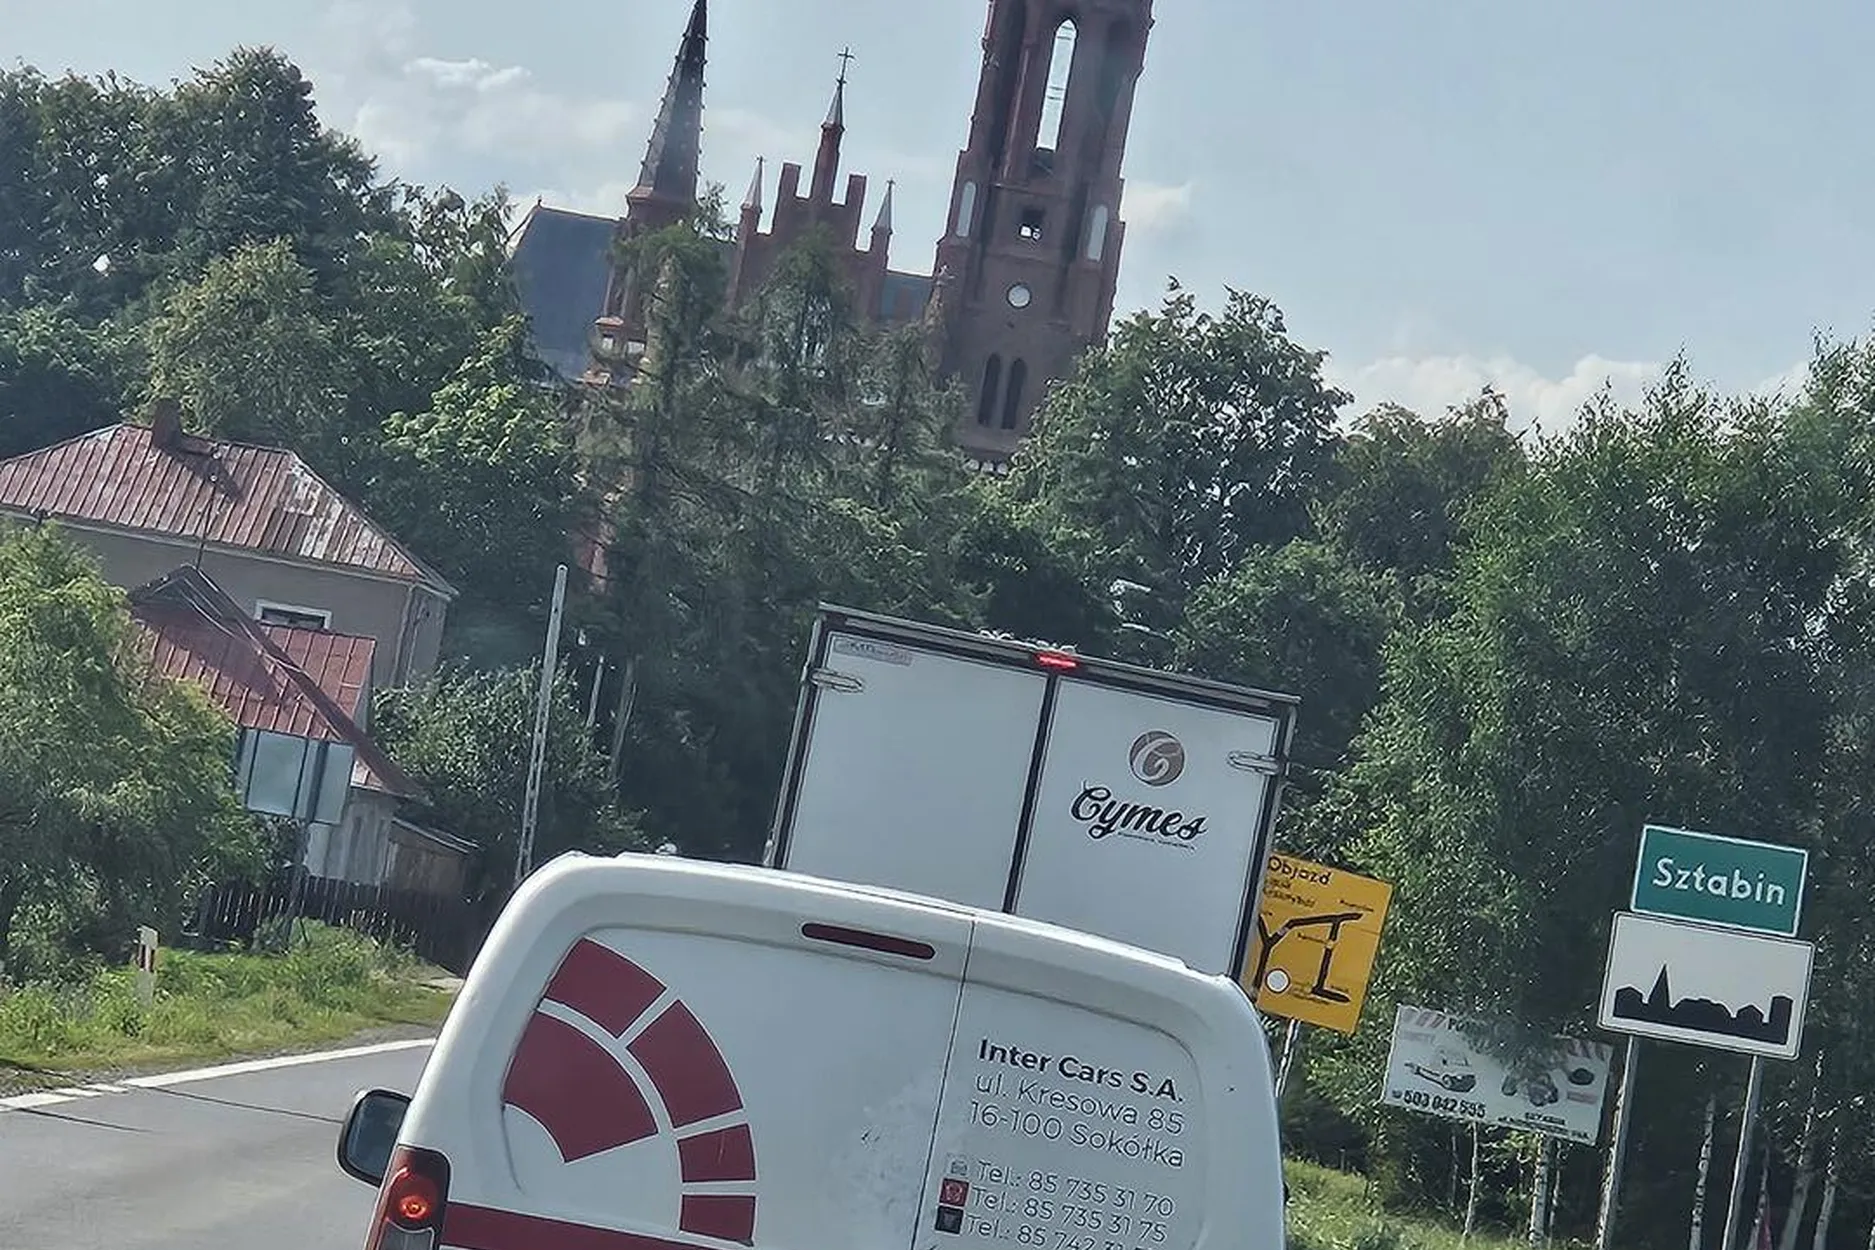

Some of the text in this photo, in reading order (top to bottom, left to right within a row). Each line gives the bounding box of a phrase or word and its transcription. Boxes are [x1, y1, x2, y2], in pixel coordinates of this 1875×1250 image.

[1070, 780, 1208, 841] Cymes
[1267, 855, 1332, 886] Objazd
[1652, 857, 1786, 906] Sztabin
[977, 1038, 1184, 1102] Inter Cars S.A.
[976, 1073, 1184, 1135] ul. Kresowa 85
[970, 1100, 1184, 1168] 16-100 Sokółka
[1028, 1171, 1059, 1194] 85
[1066, 1178, 1108, 1204] 735
[1112, 1188, 1136, 1209] 31
[1143, 1194, 1175, 1218] 70
[1017, 1225, 1047, 1247] 85
[1023, 1197, 1054, 1221] 85
[1061, 1205, 1103, 1231] 735
[1108, 1215, 1131, 1236] 31
[1137, 1220, 1168, 1243] 75
